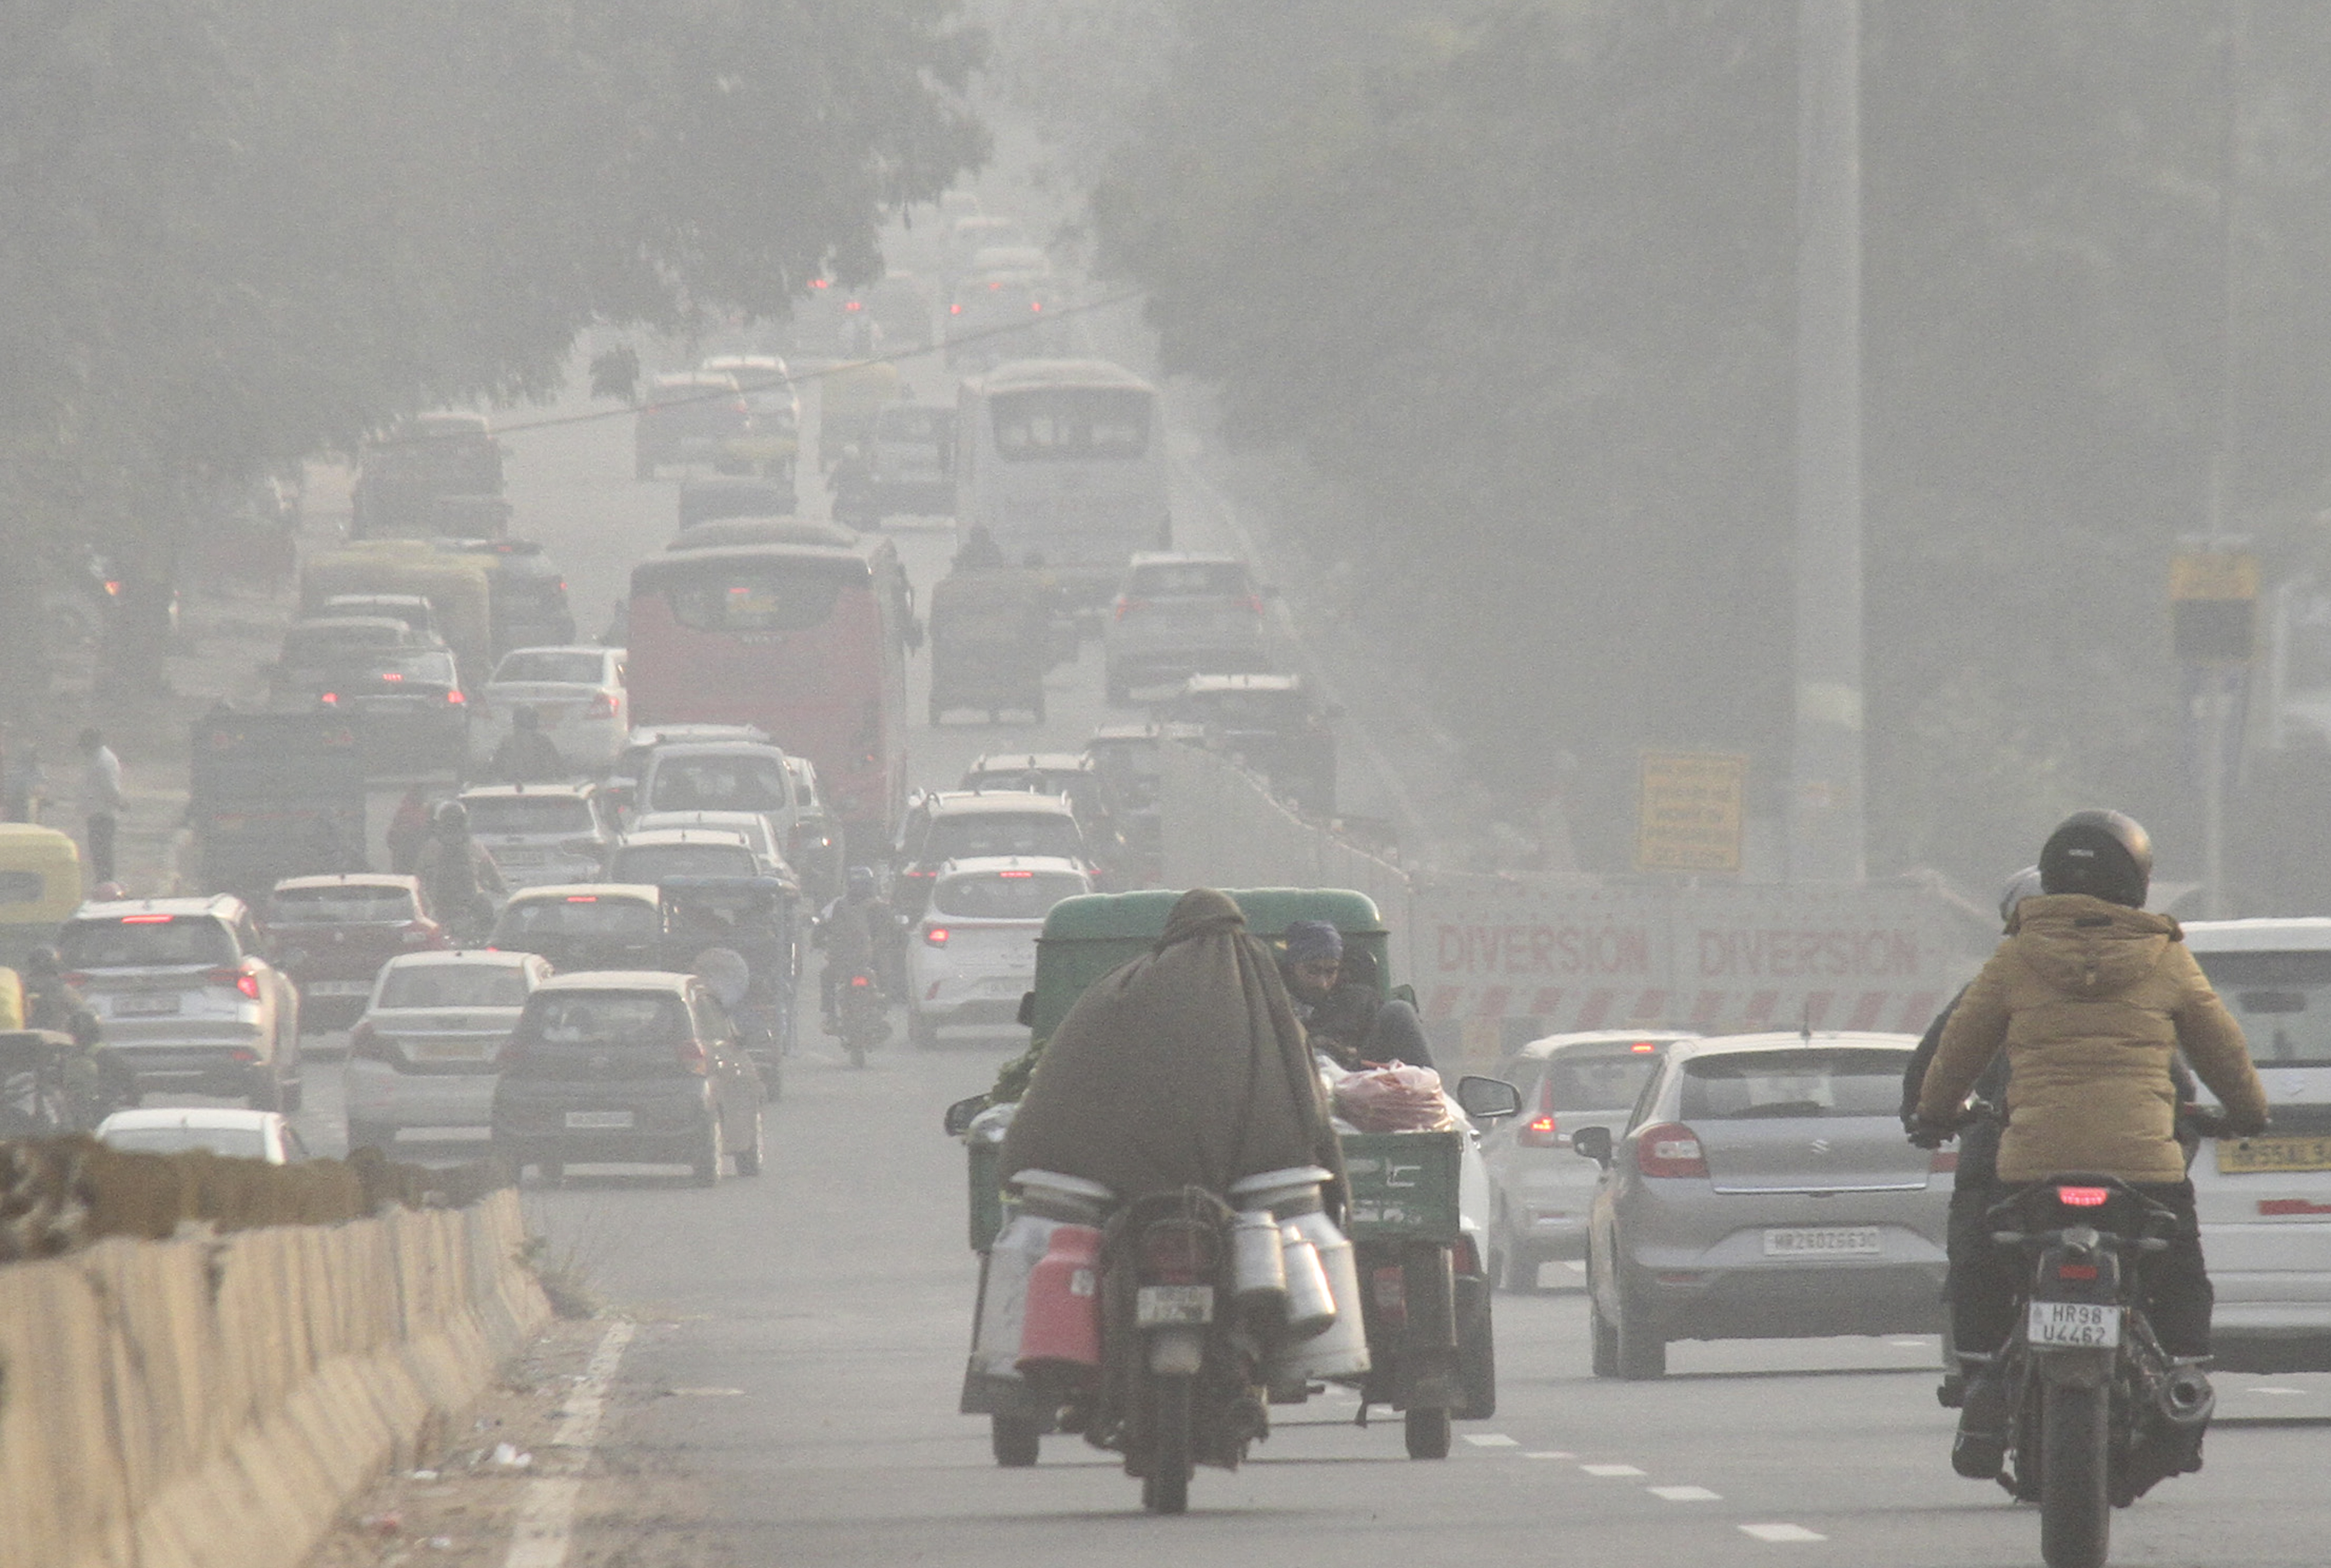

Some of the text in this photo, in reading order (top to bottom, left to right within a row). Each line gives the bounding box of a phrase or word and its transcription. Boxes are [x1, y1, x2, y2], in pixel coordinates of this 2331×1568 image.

[1437, 924, 1649, 972] DIVERSION
[1698, 928, 1919, 978] DIVERSION
[2053, 1305, 2102, 1325] HR98
[2044, 1325, 2106, 1345] U4462
